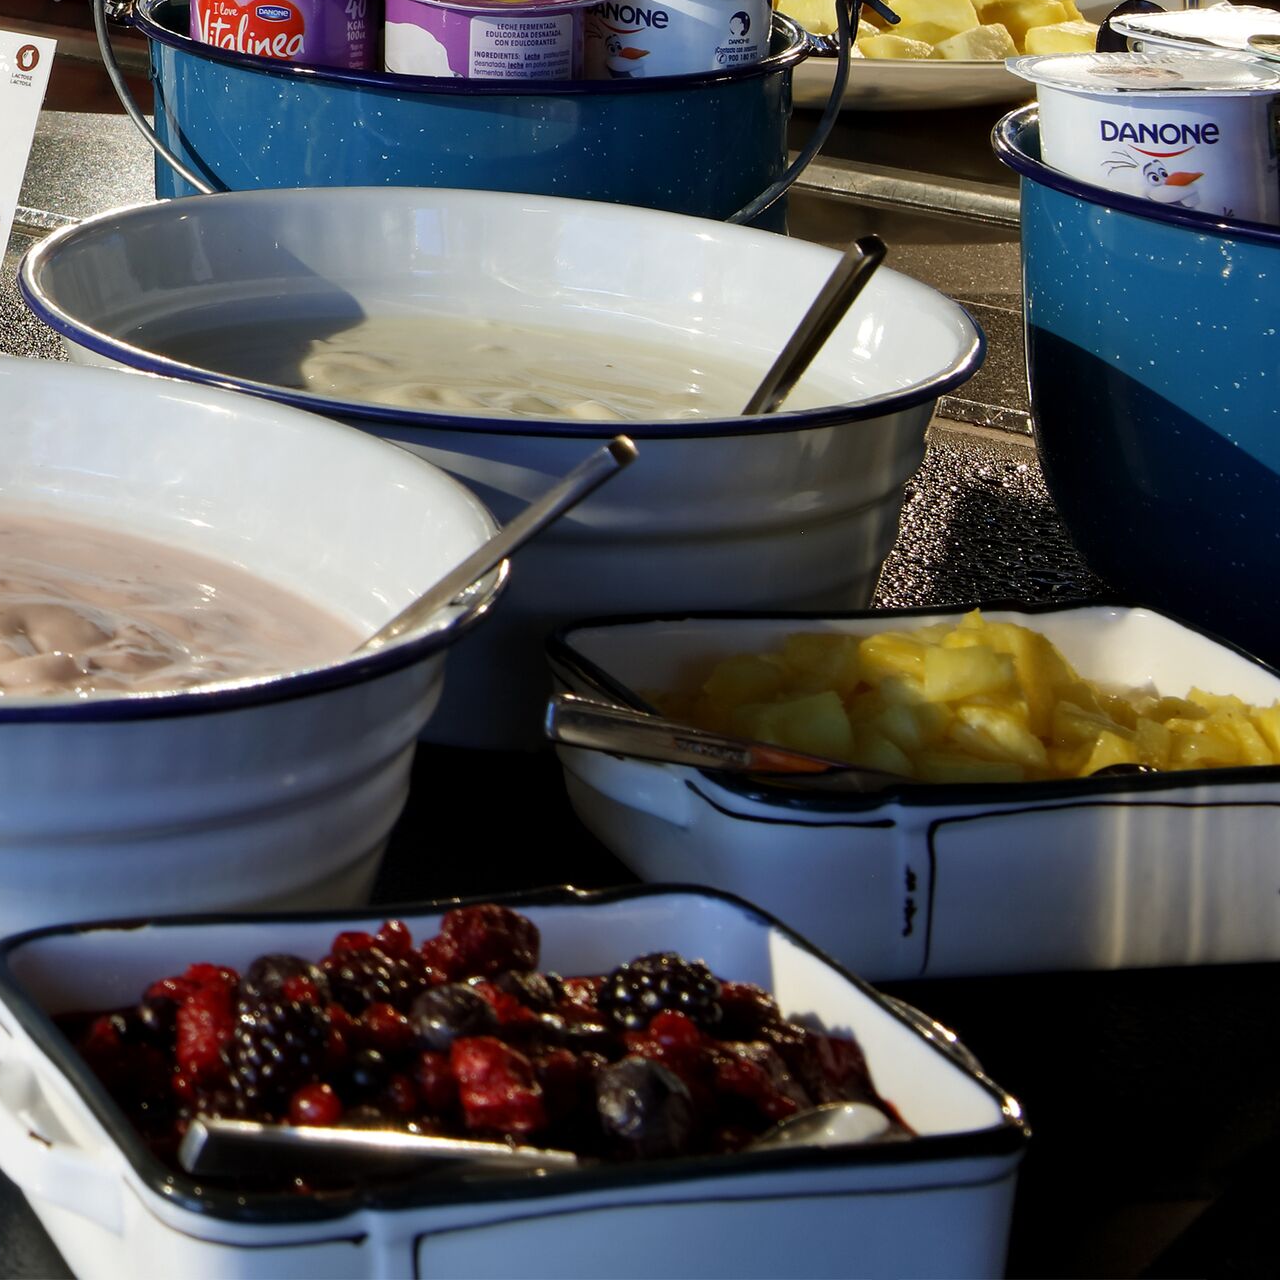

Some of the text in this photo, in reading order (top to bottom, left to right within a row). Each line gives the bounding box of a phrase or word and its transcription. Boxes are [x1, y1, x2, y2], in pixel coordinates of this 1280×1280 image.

[213, 2, 239, 17] I love
[195, 0, 306, 57] Vitalinea
[497, 23, 557, 31] LECHE FERMENTADA
[474, 51, 520, 60] INGREDIENTES:
[524, 52, 541, 61] Leche
[507, 62, 524, 70] leche
